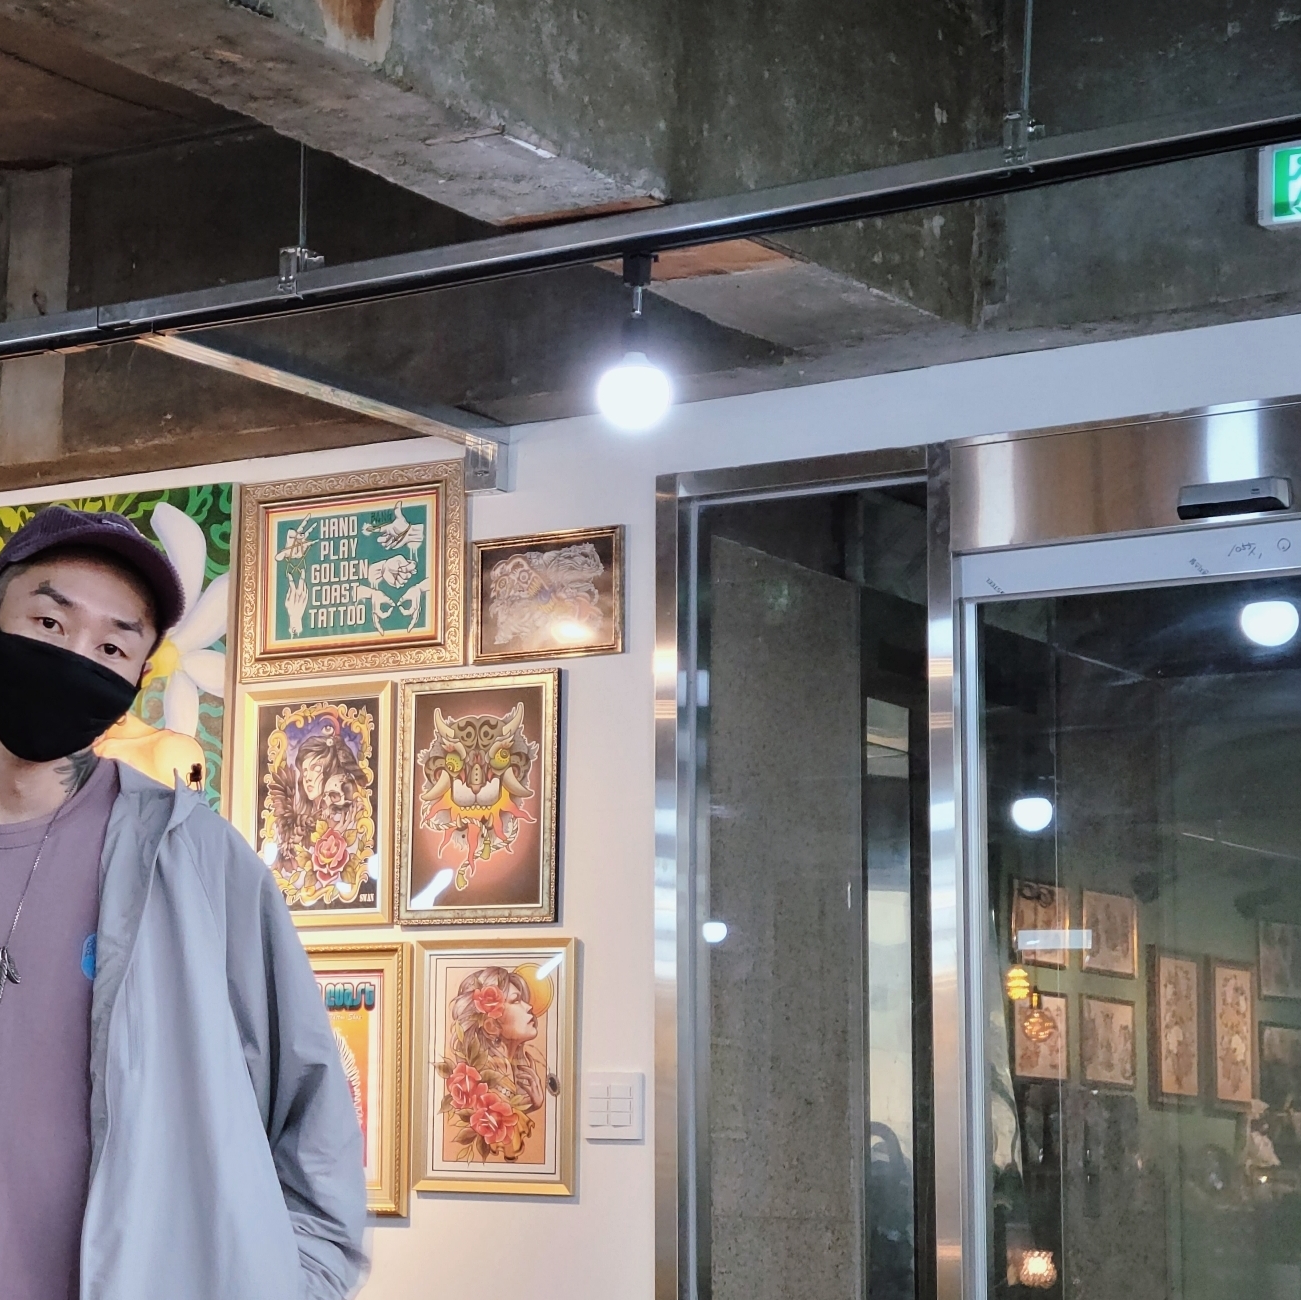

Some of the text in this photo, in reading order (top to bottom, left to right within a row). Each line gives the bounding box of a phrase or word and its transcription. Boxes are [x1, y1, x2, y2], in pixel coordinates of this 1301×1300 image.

[320, 515, 358, 539] HAND
[320, 537, 358, 561] PLAY
[311, 558, 369, 584] GOLDEN
[312, 582, 360, 606] COAST
[308, 604, 366, 629] TATTOO
